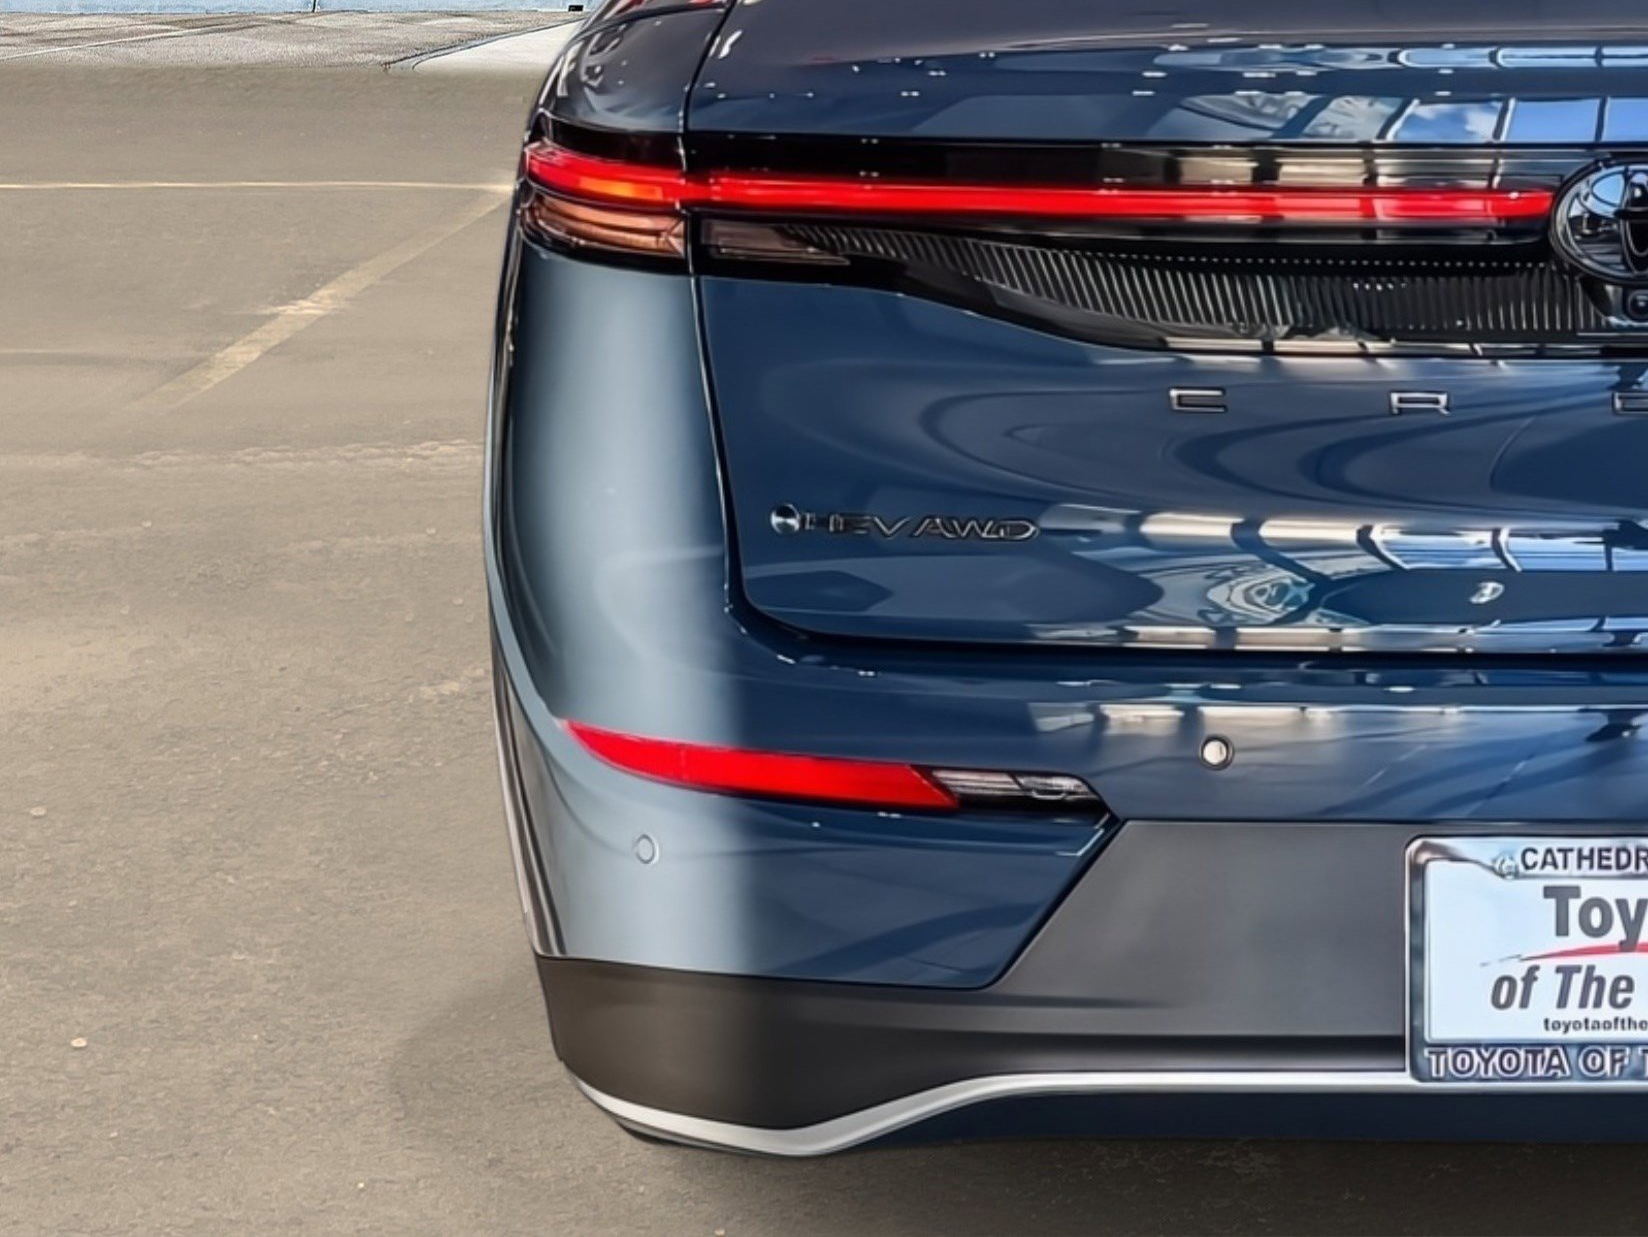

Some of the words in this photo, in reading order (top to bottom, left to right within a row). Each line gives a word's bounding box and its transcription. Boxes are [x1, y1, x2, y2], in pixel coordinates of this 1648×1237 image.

[1490, 964, 1541, 1010] of
[1555, 964, 1635, 1009] The
[1425, 1047, 1568, 1078] TOYOTA
[1579, 1047, 1631, 1077] OF
